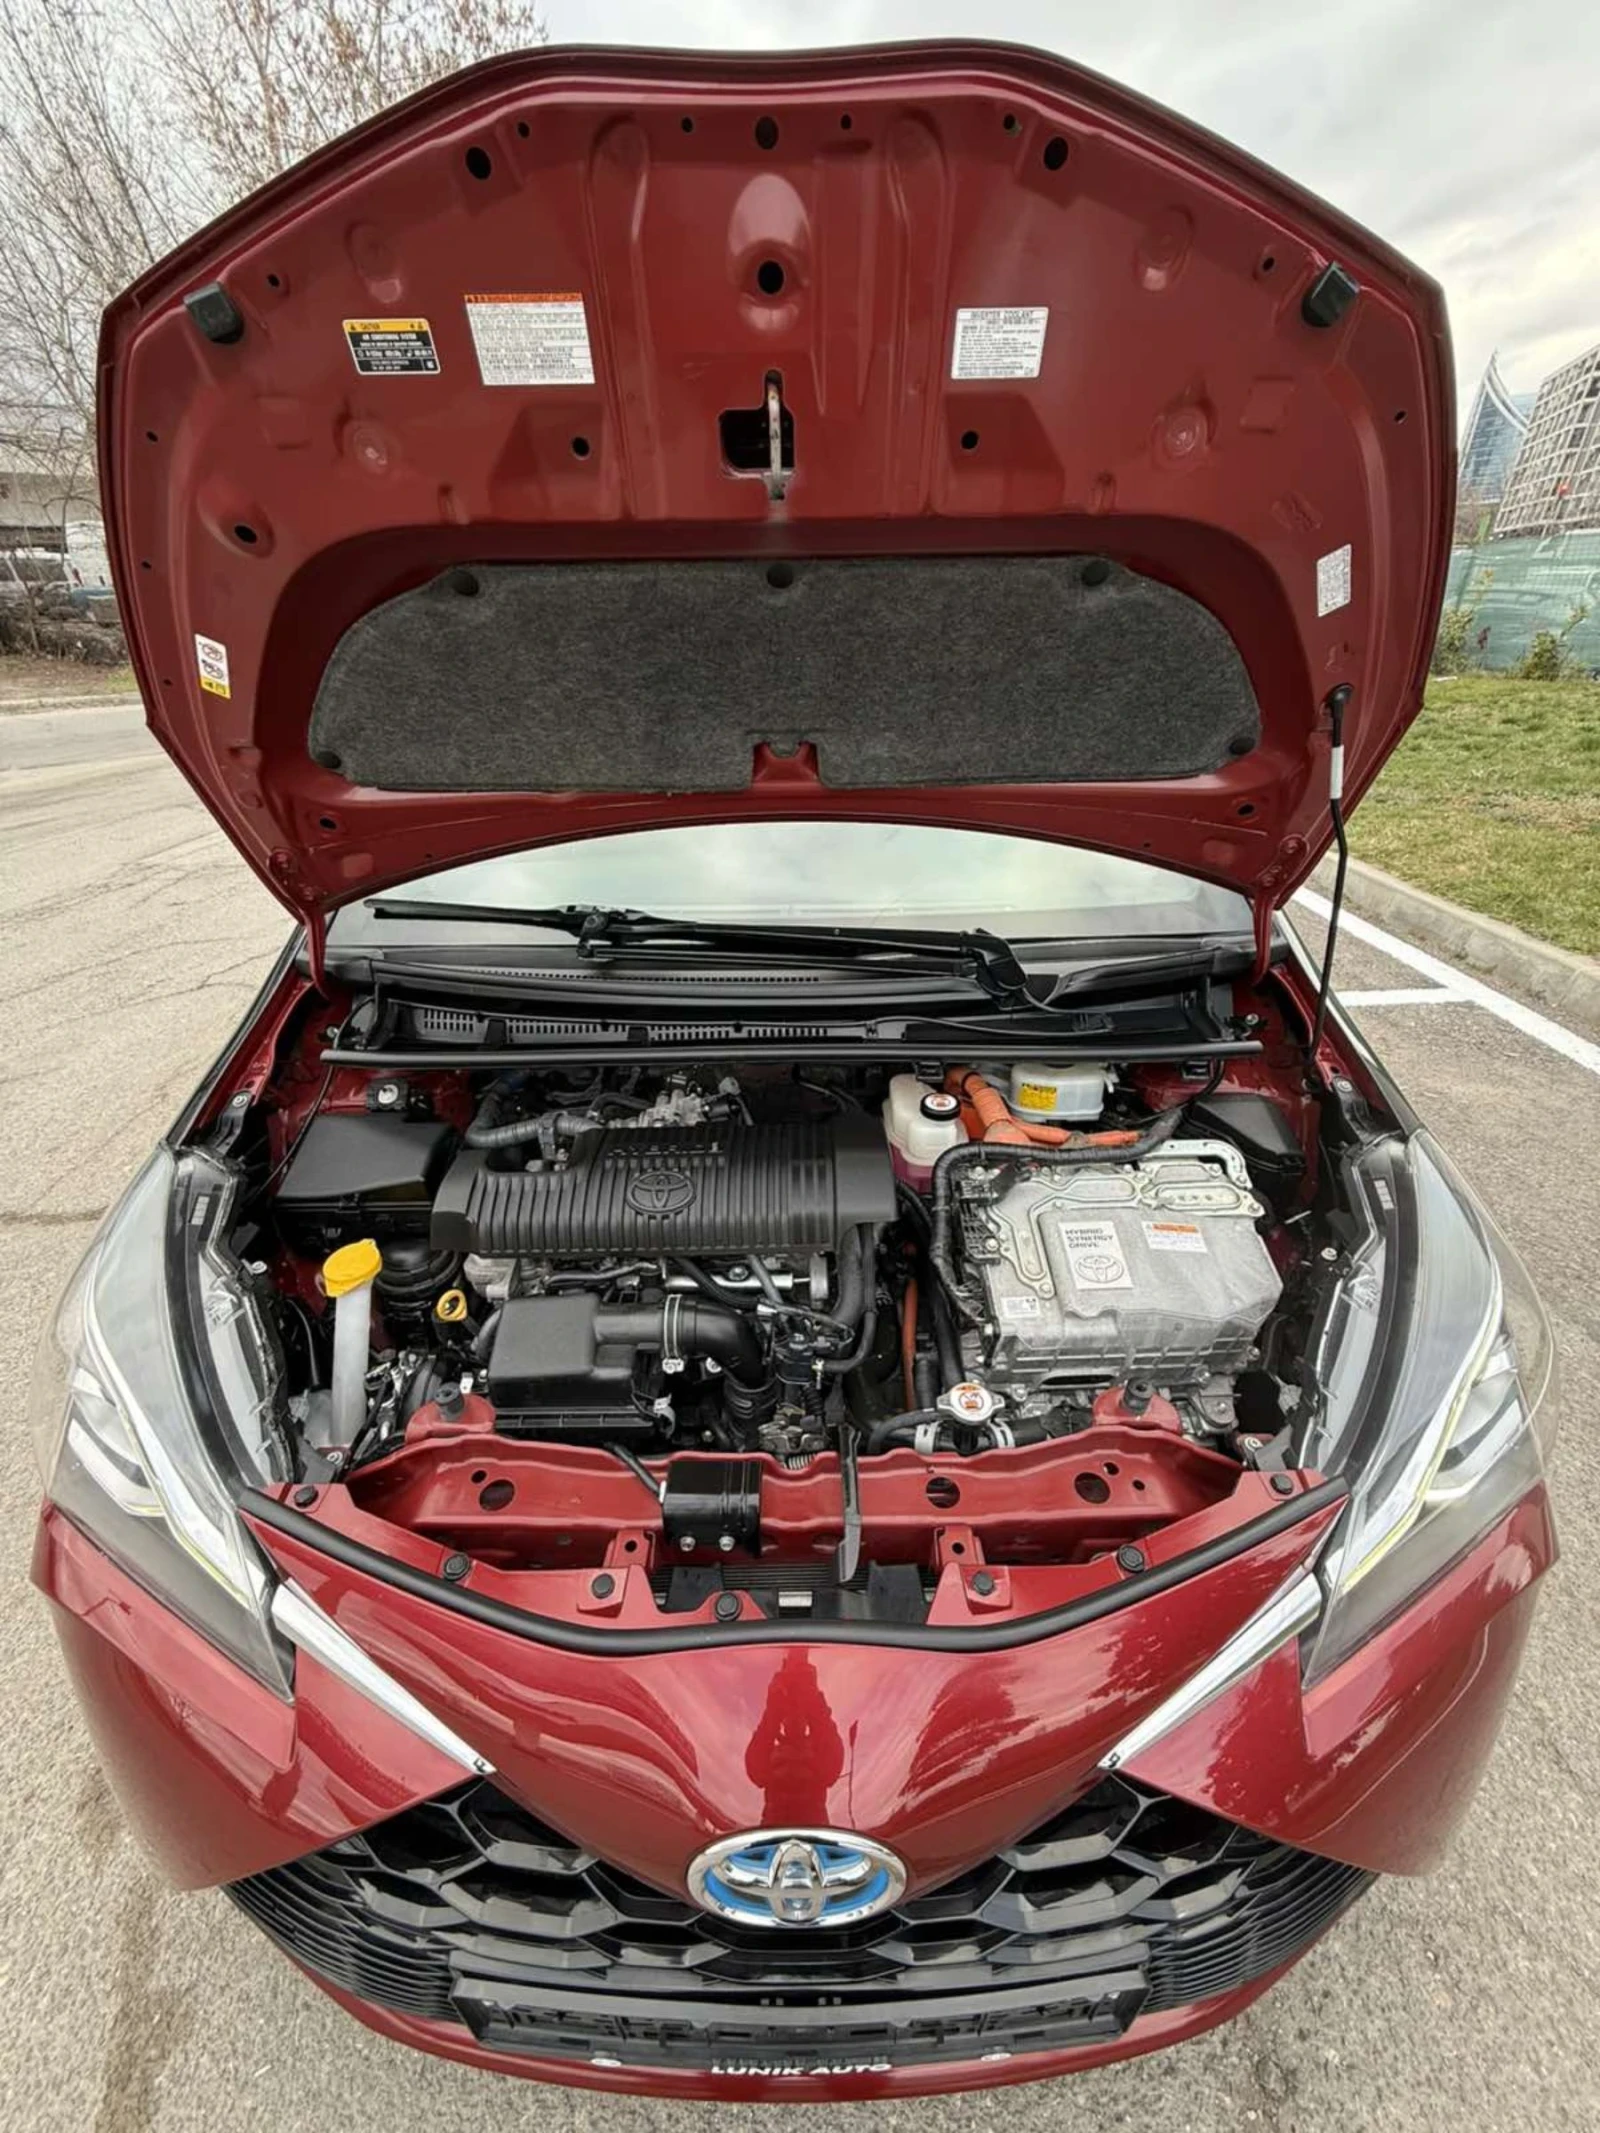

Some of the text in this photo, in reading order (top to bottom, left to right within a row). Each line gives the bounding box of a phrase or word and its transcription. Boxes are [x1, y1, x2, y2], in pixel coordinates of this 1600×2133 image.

[1065, 1227, 1104, 1235] HYBRID
[711, 2063, 893, 2075] LUNIK AUTO
